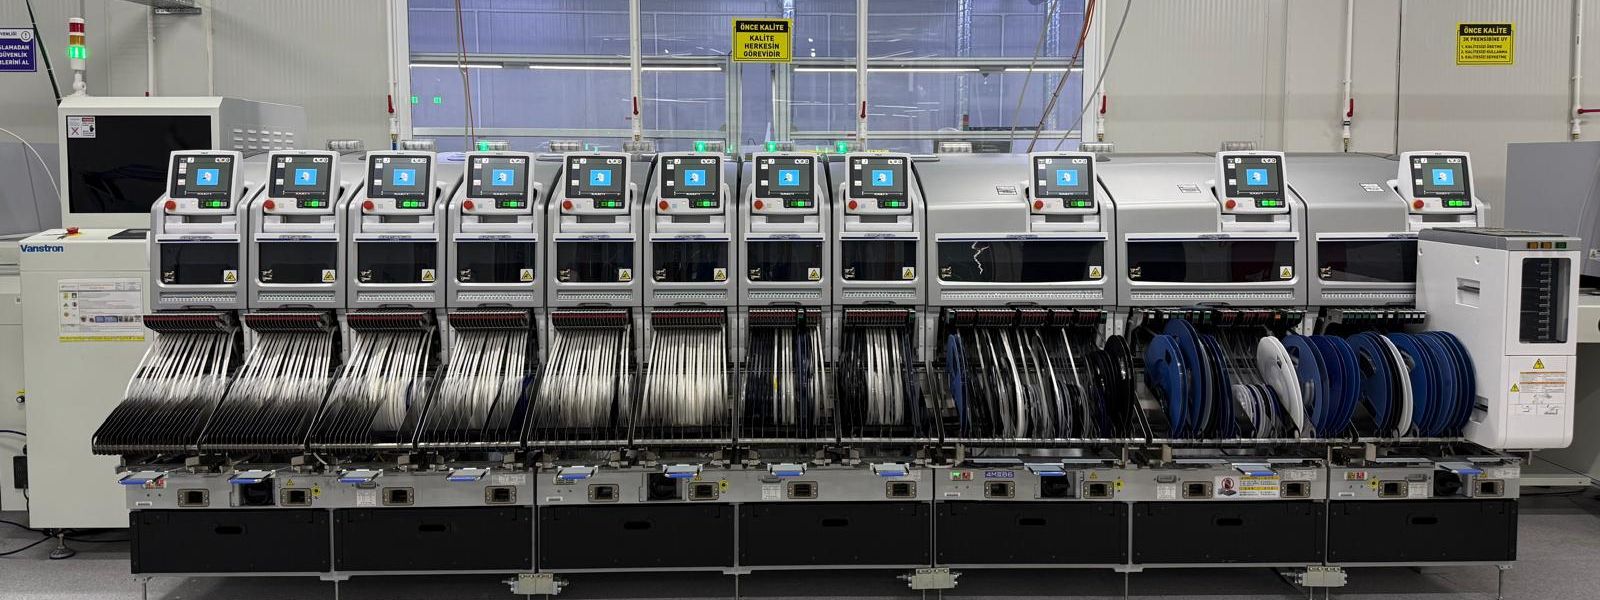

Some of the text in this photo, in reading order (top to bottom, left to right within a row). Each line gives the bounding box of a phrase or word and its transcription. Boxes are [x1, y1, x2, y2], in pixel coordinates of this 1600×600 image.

[740, 23, 784, 31] ÖNCE KALİTE
[1464, 26, 1508, 34] ÖNCE KALİTE
[20, 244, 64, 253] Vanstron
